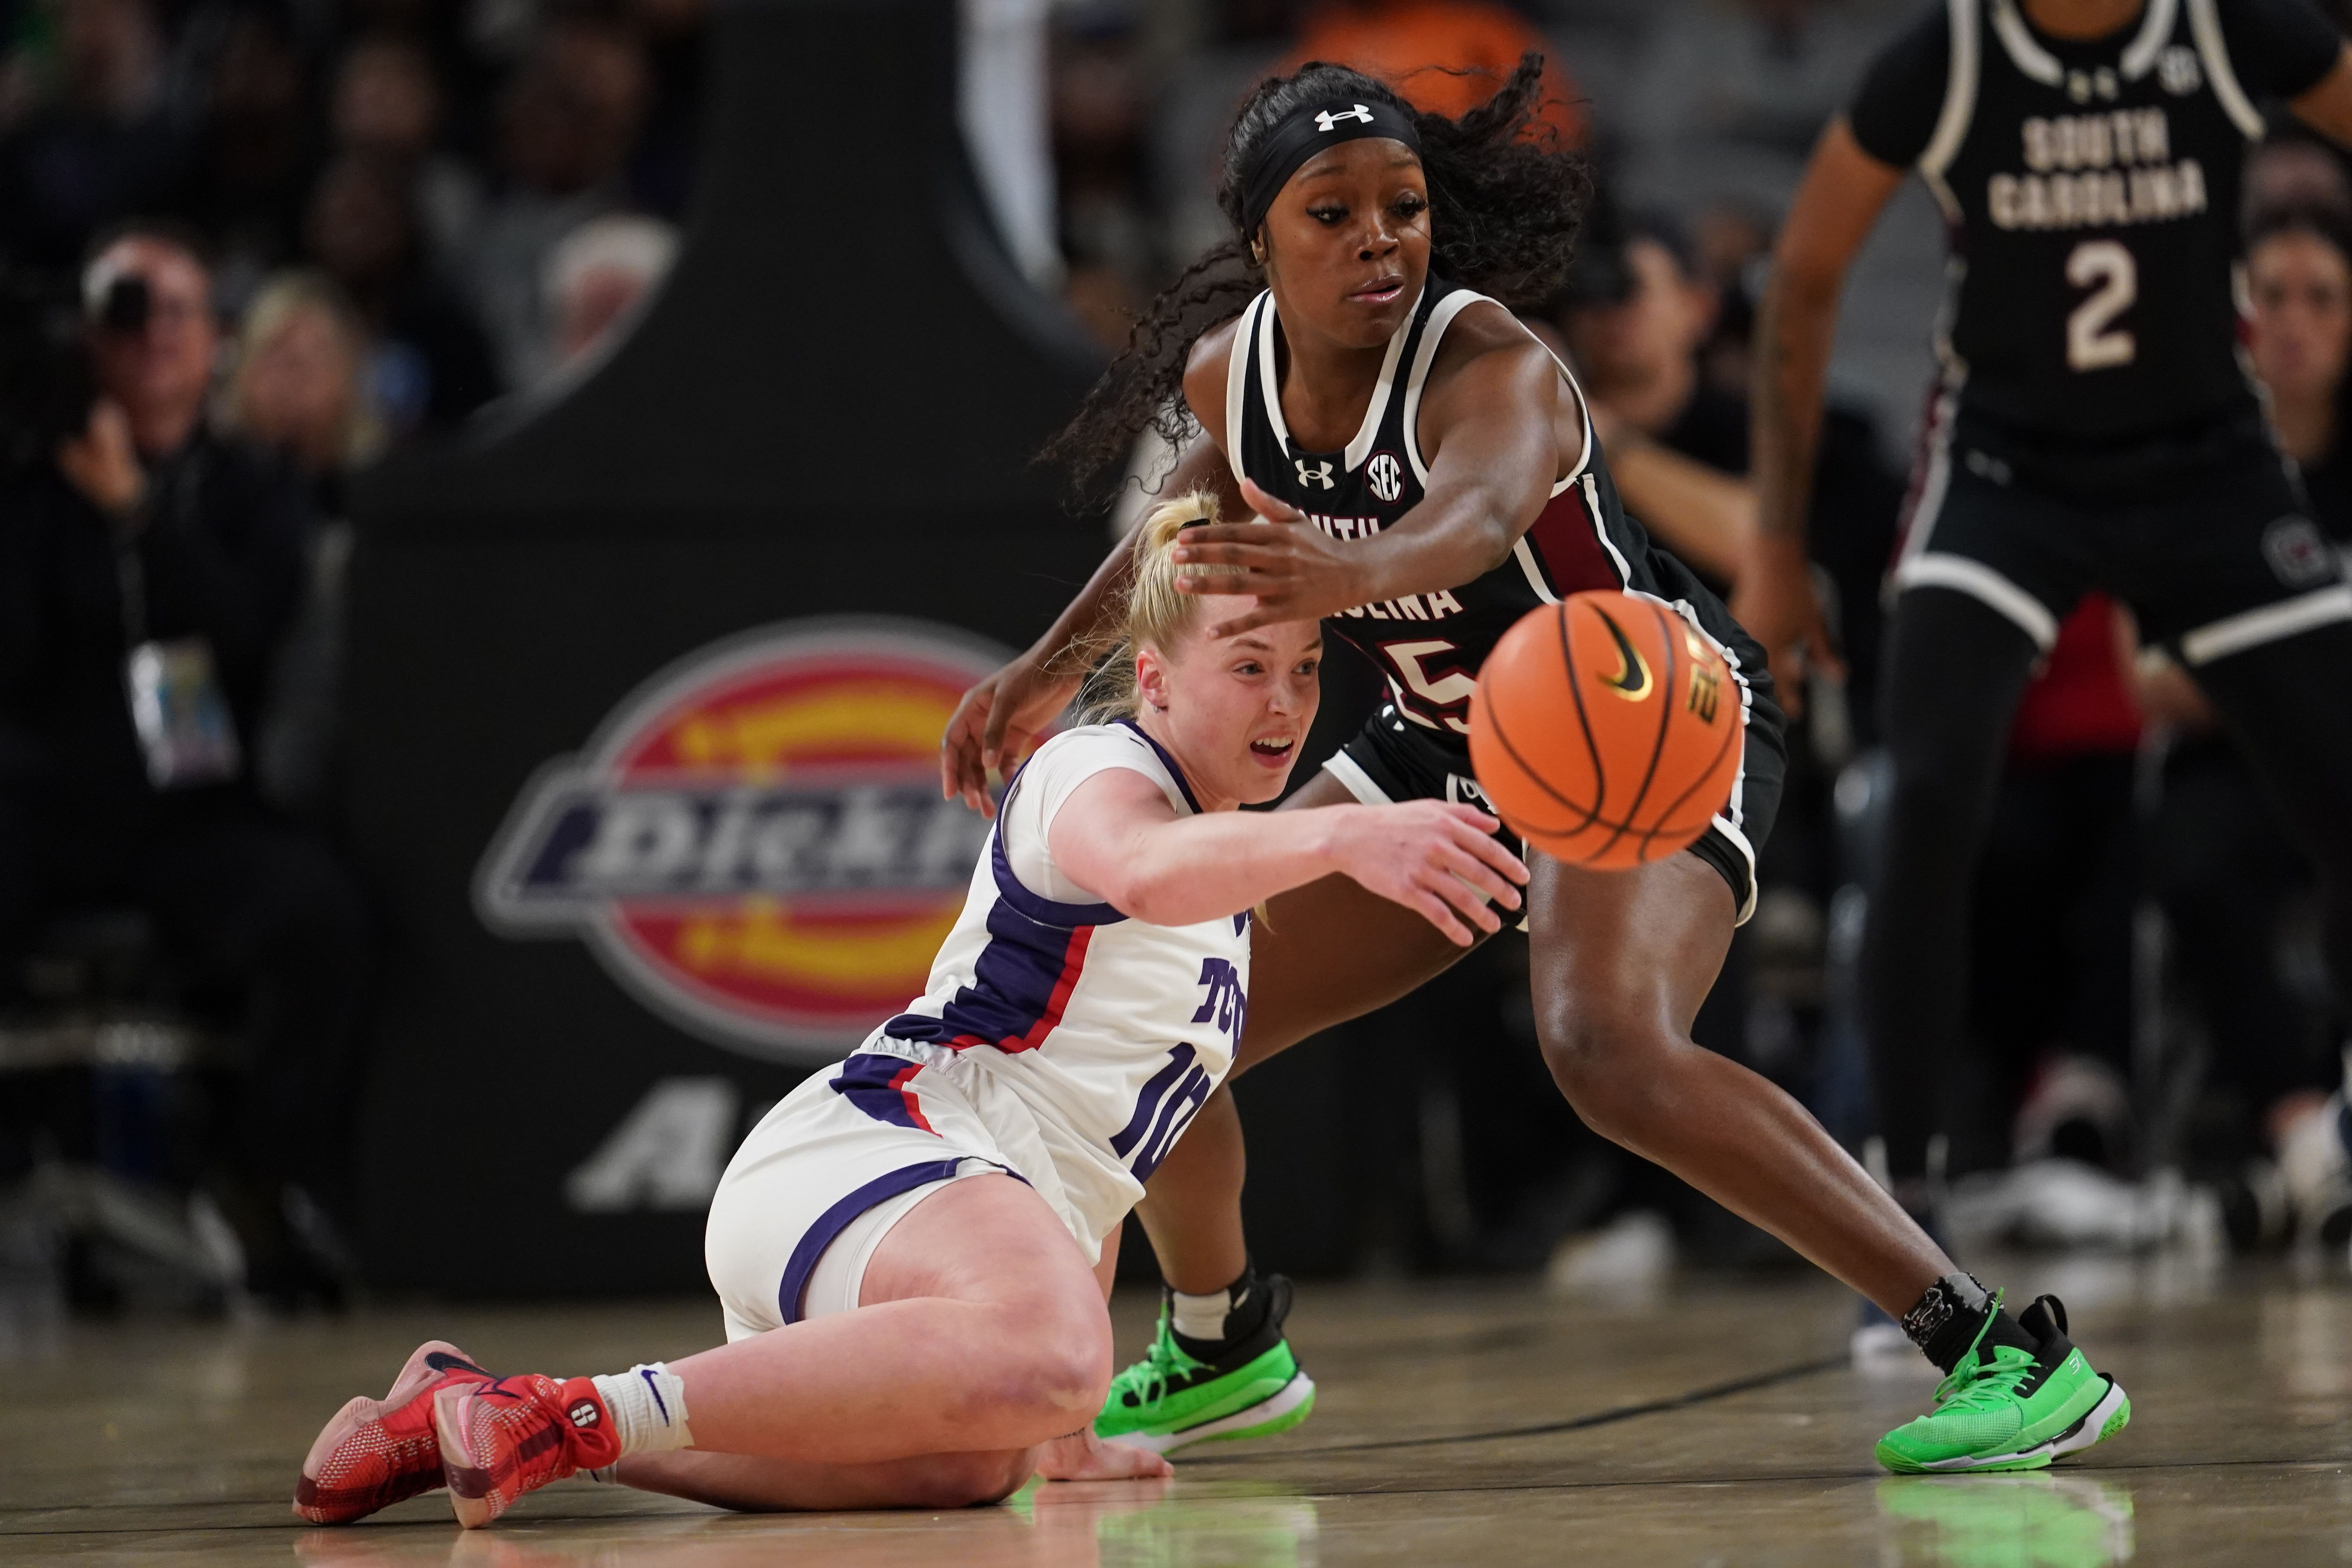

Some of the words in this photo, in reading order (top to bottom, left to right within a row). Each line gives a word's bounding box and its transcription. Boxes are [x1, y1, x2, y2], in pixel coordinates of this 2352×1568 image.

[1987, 158, 2208, 230] CAROLINA
[2065, 238, 2139, 371] 2
[1368, 454, 1401, 501] SEC
[1384, 639, 1479, 735] 5
